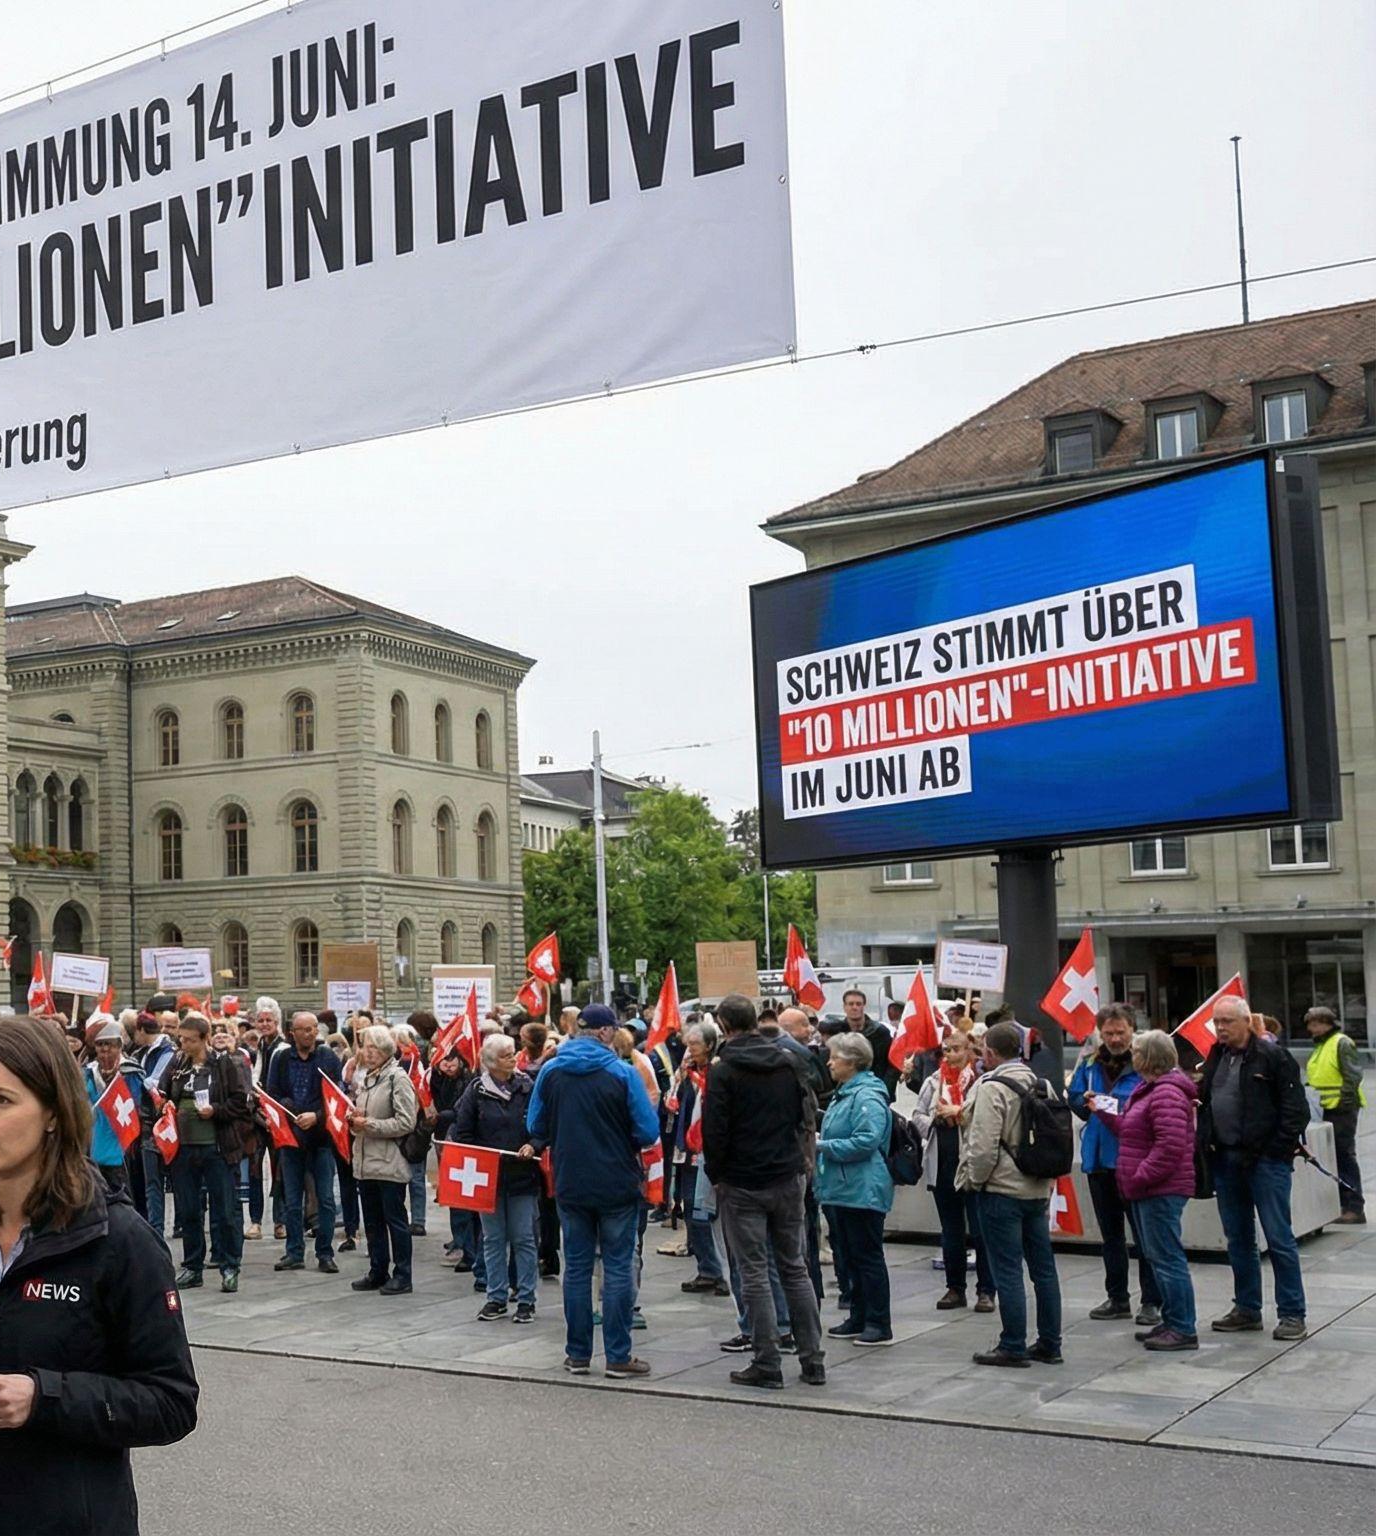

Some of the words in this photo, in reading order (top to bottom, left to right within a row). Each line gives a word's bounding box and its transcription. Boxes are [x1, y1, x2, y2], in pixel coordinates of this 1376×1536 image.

[186, 73, 252, 162] 14.
[268, 22, 395, 139] JUNI:
[786, 638, 922, 705] SCHWEIZ
[933, 604, 1069, 674] STIMMT
[1082, 580, 1185, 643] ÜBER
[788, 712, 833, 756] "10
[791, 768, 825, 811] IM
[835, 753, 907, 804] JUNI
[919, 746, 961, 791] AB
[26, 1282, 81, 1302] NEWS
